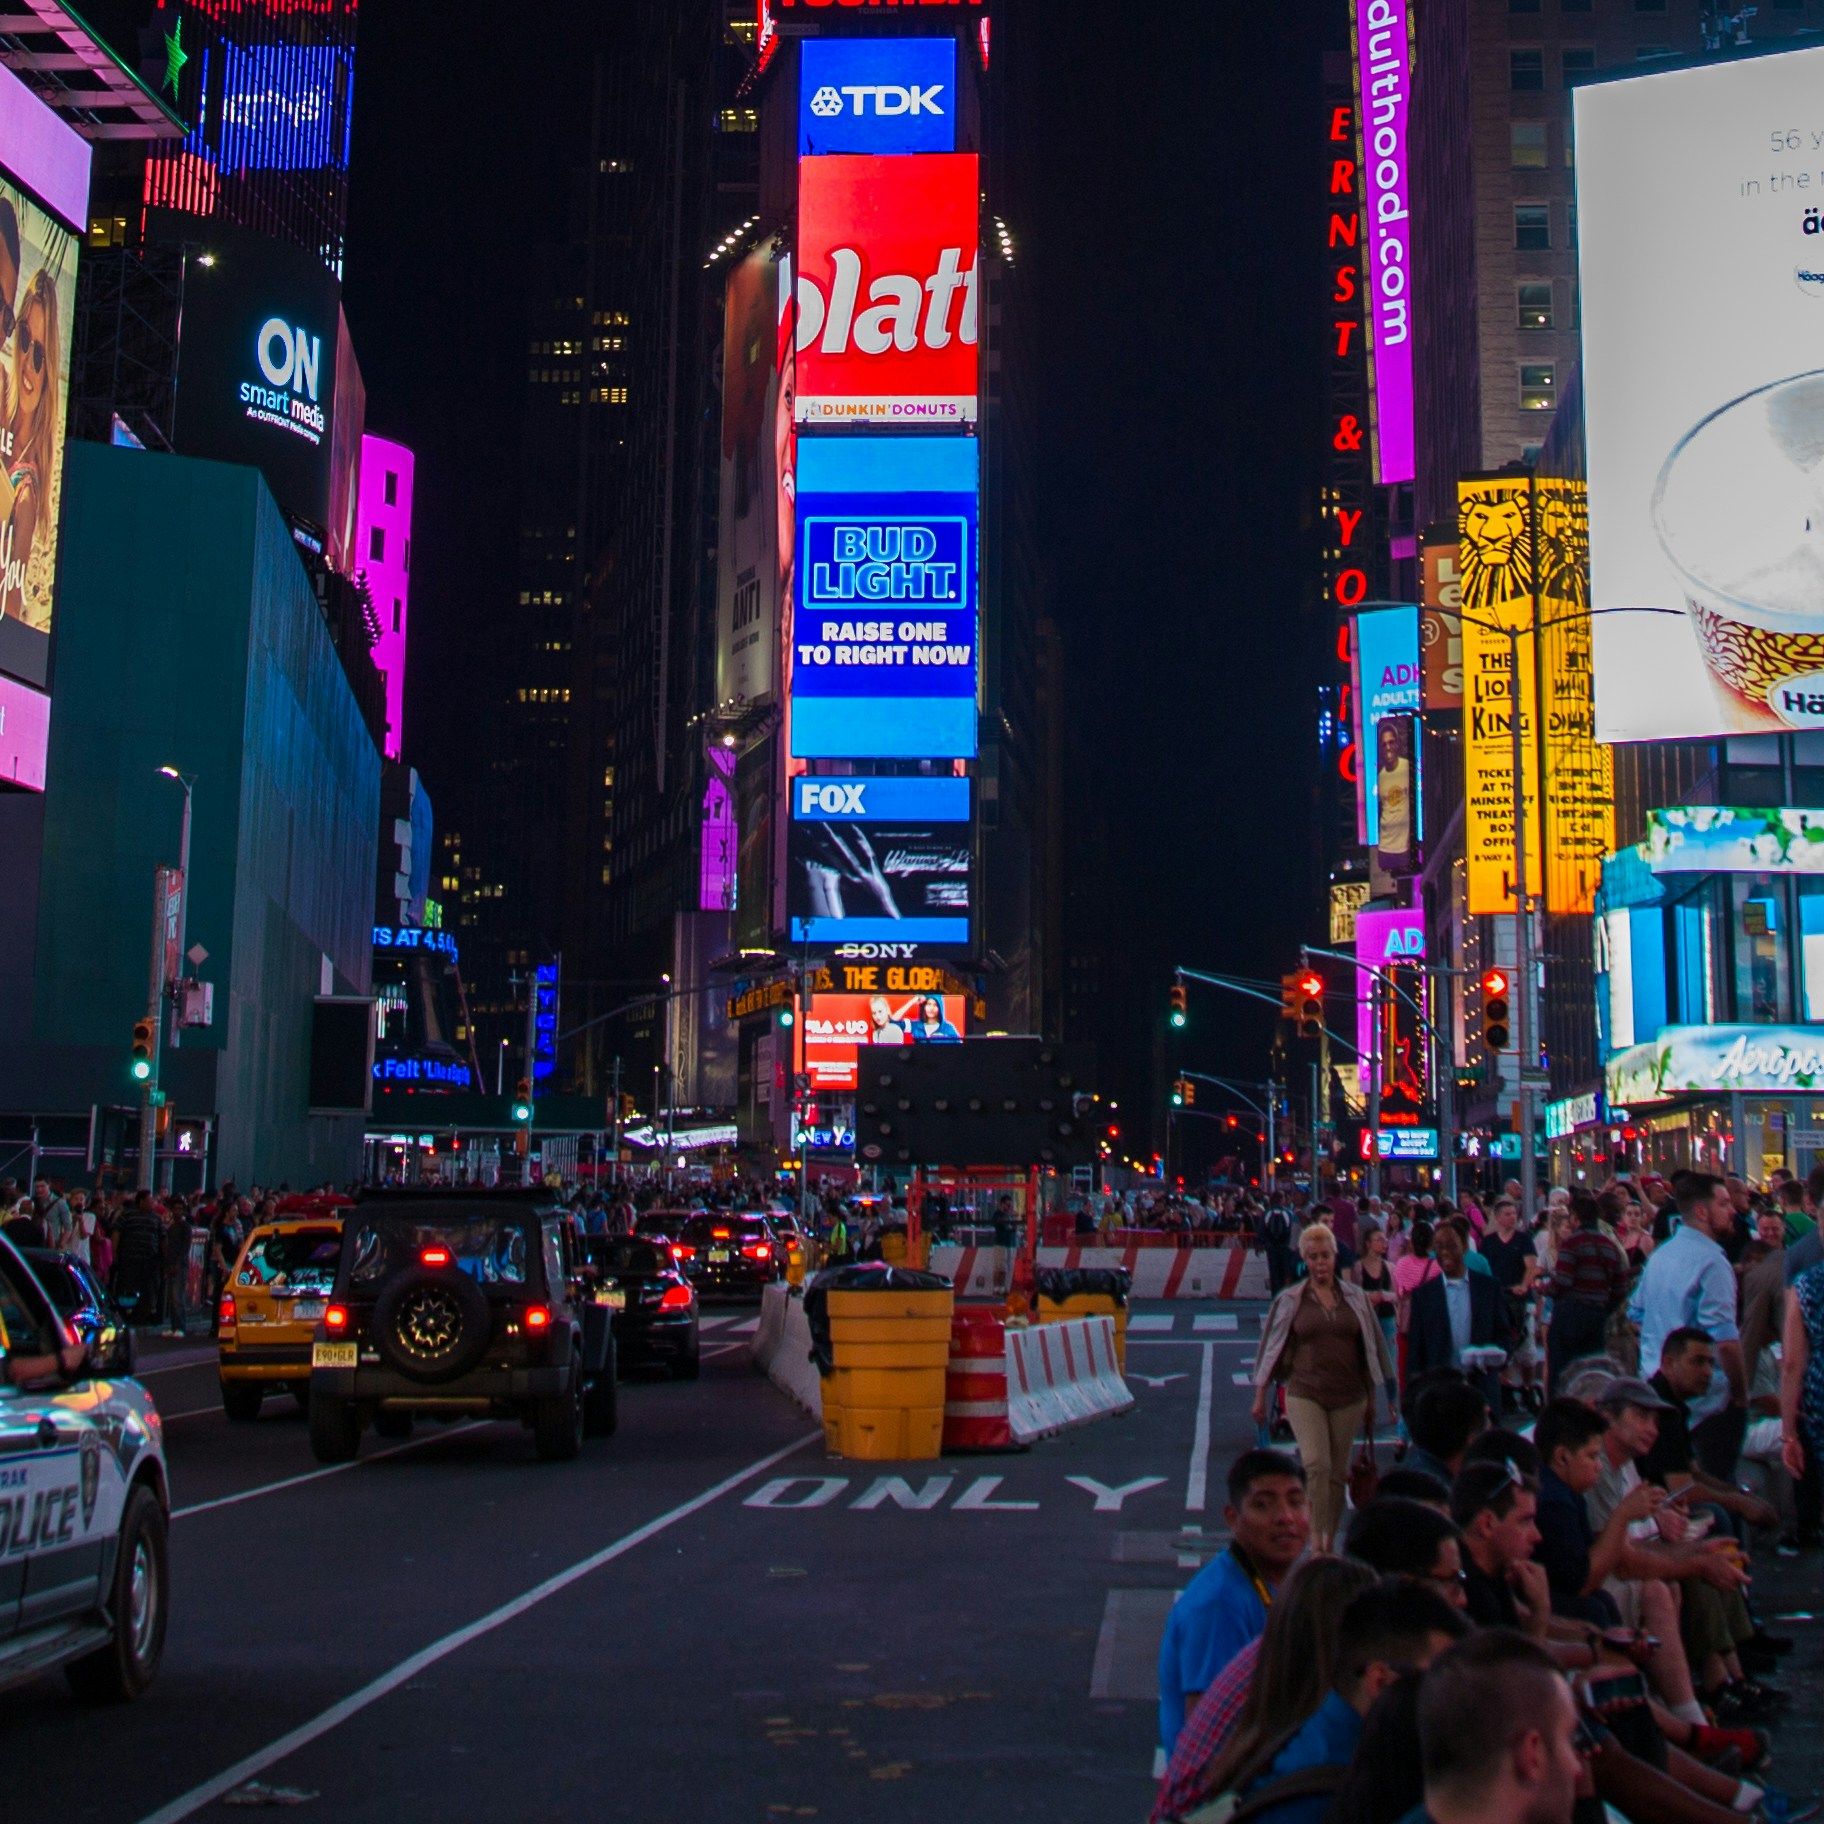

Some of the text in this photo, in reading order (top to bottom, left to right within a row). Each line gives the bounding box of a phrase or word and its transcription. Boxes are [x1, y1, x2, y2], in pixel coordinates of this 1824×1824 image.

[840, 84, 945, 116] TDK
[1770, 128, 1802, 153] 56
[1739, 179, 1761, 197] in
[1770, 172, 1811, 192] the
[1328, 105, 1358, 358] ERNST
[257, 317, 321, 402] ON
[239, 381, 325, 433] smart media
[822, 402, 957, 417] DUNKIN' DONUTS
[1332, 414, 1364, 453] &
[833, 526, 937, 563] BUD
[822, 622, 947, 642] RAISE ONE
[798, 645, 971, 665] TO RIGHT NOW
[1473, 674, 1523, 704] LIO
[800, 783, 866, 814] FOX
[1470, 795, 1535, 807] MINSKFF
[843, 943, 918, 959] SONY
[843, 966, 879, 990] THE
[384, 1057, 420, 1079] Felt
[742, 1474, 1169, 1512] ONLY
